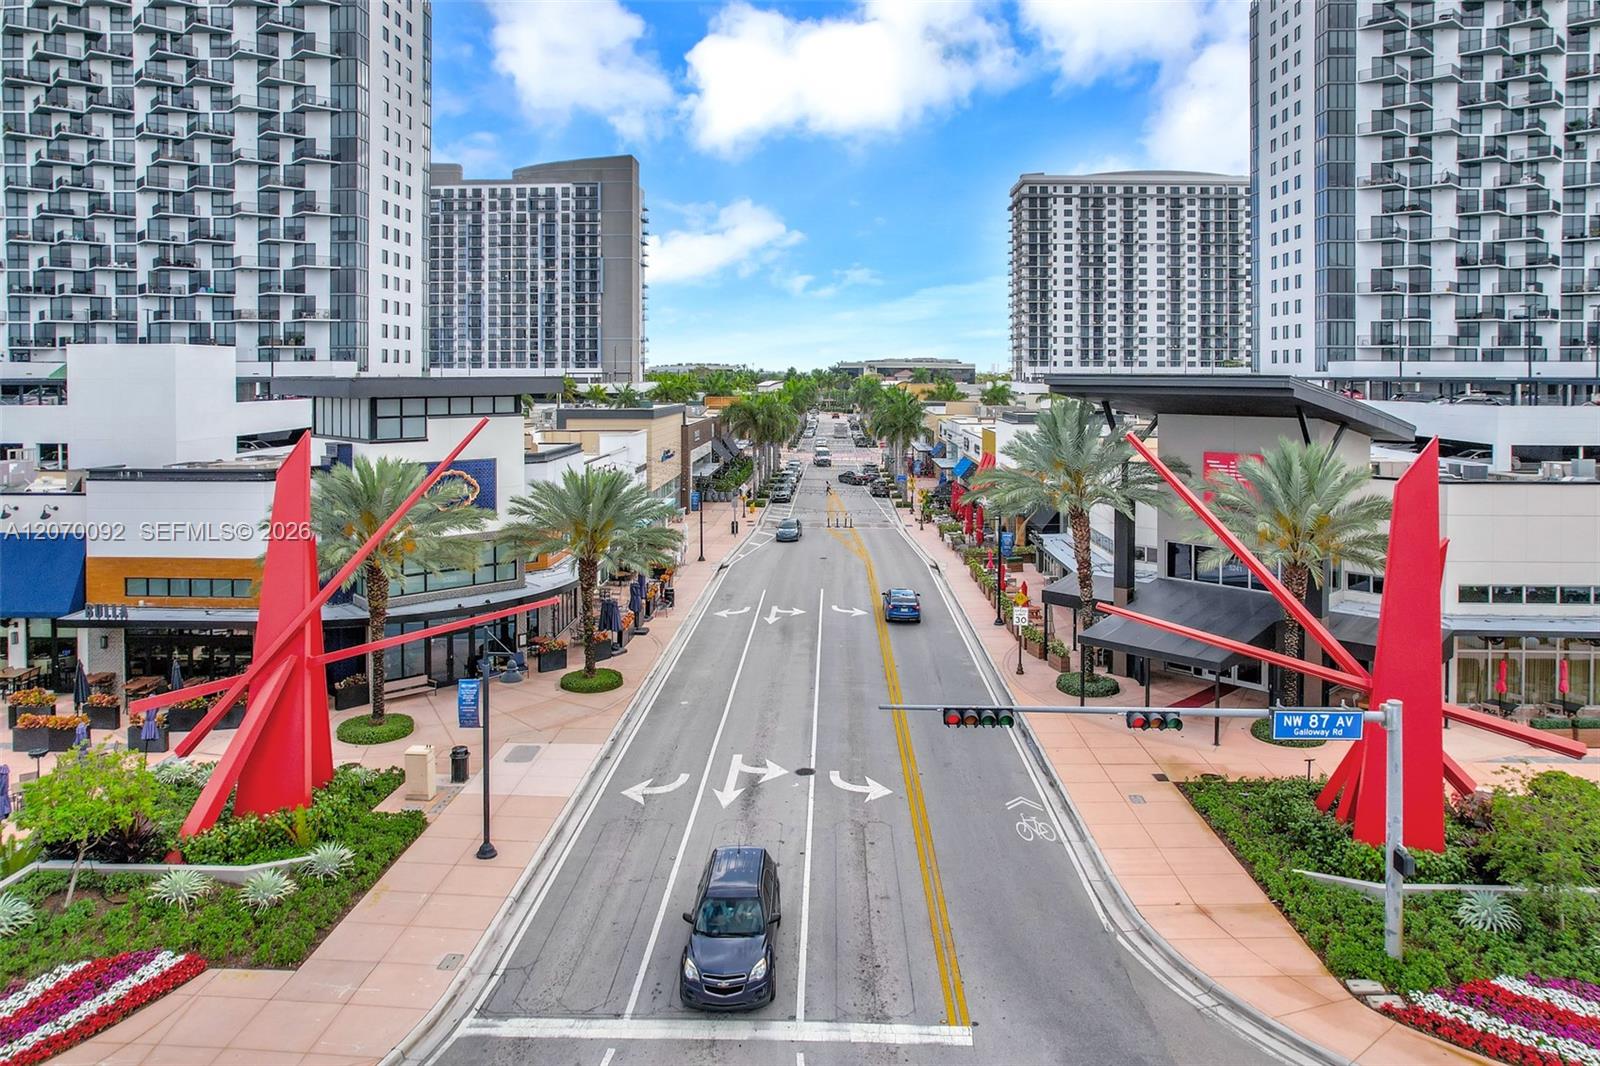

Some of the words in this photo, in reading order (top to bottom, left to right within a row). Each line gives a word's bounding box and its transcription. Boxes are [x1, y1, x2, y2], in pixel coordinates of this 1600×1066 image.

[85, 602, 128, 618] BULLA
[1015, 616, 1027, 624] 30
[1283, 715, 1303, 727] NW
[1309, 714, 1330, 728] 87
[1336, 715, 1354, 727] AV
[1294, 728, 1330, 737] Galloway
[1332, 728, 1343, 736] Rd
